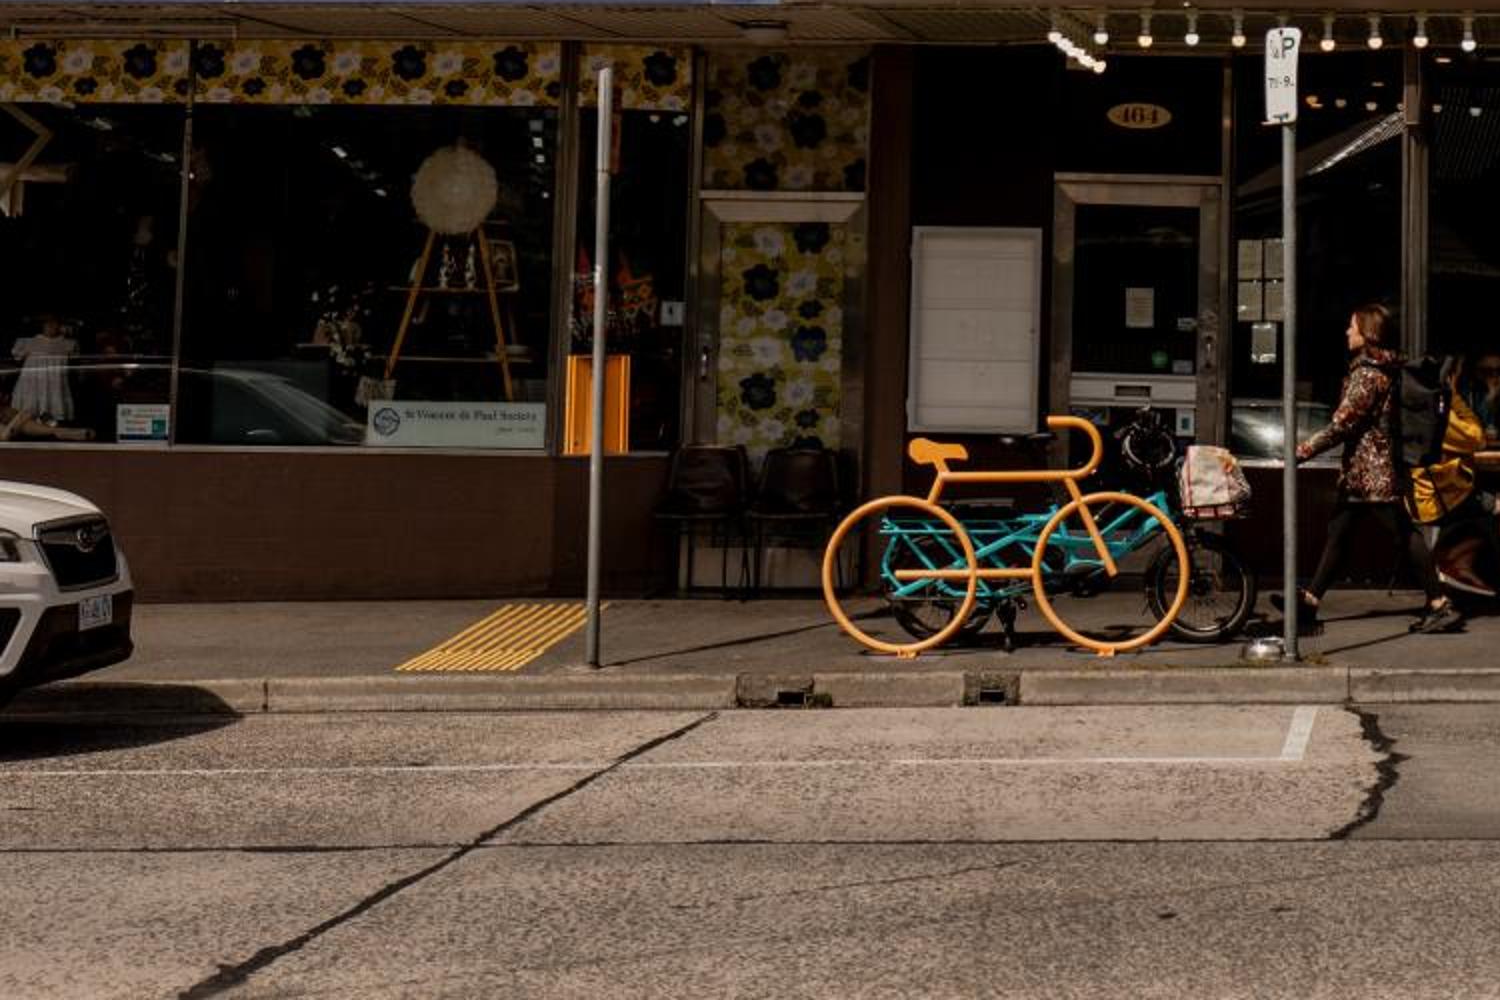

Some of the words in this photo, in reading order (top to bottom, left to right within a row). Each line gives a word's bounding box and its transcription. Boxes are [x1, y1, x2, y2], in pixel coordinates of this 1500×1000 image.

[1115, 106, 1158, 124] 464
[416, 409, 455, 420] Vincent
[473, 410, 497, 421] Paul
[499, 410, 537, 422] Society
